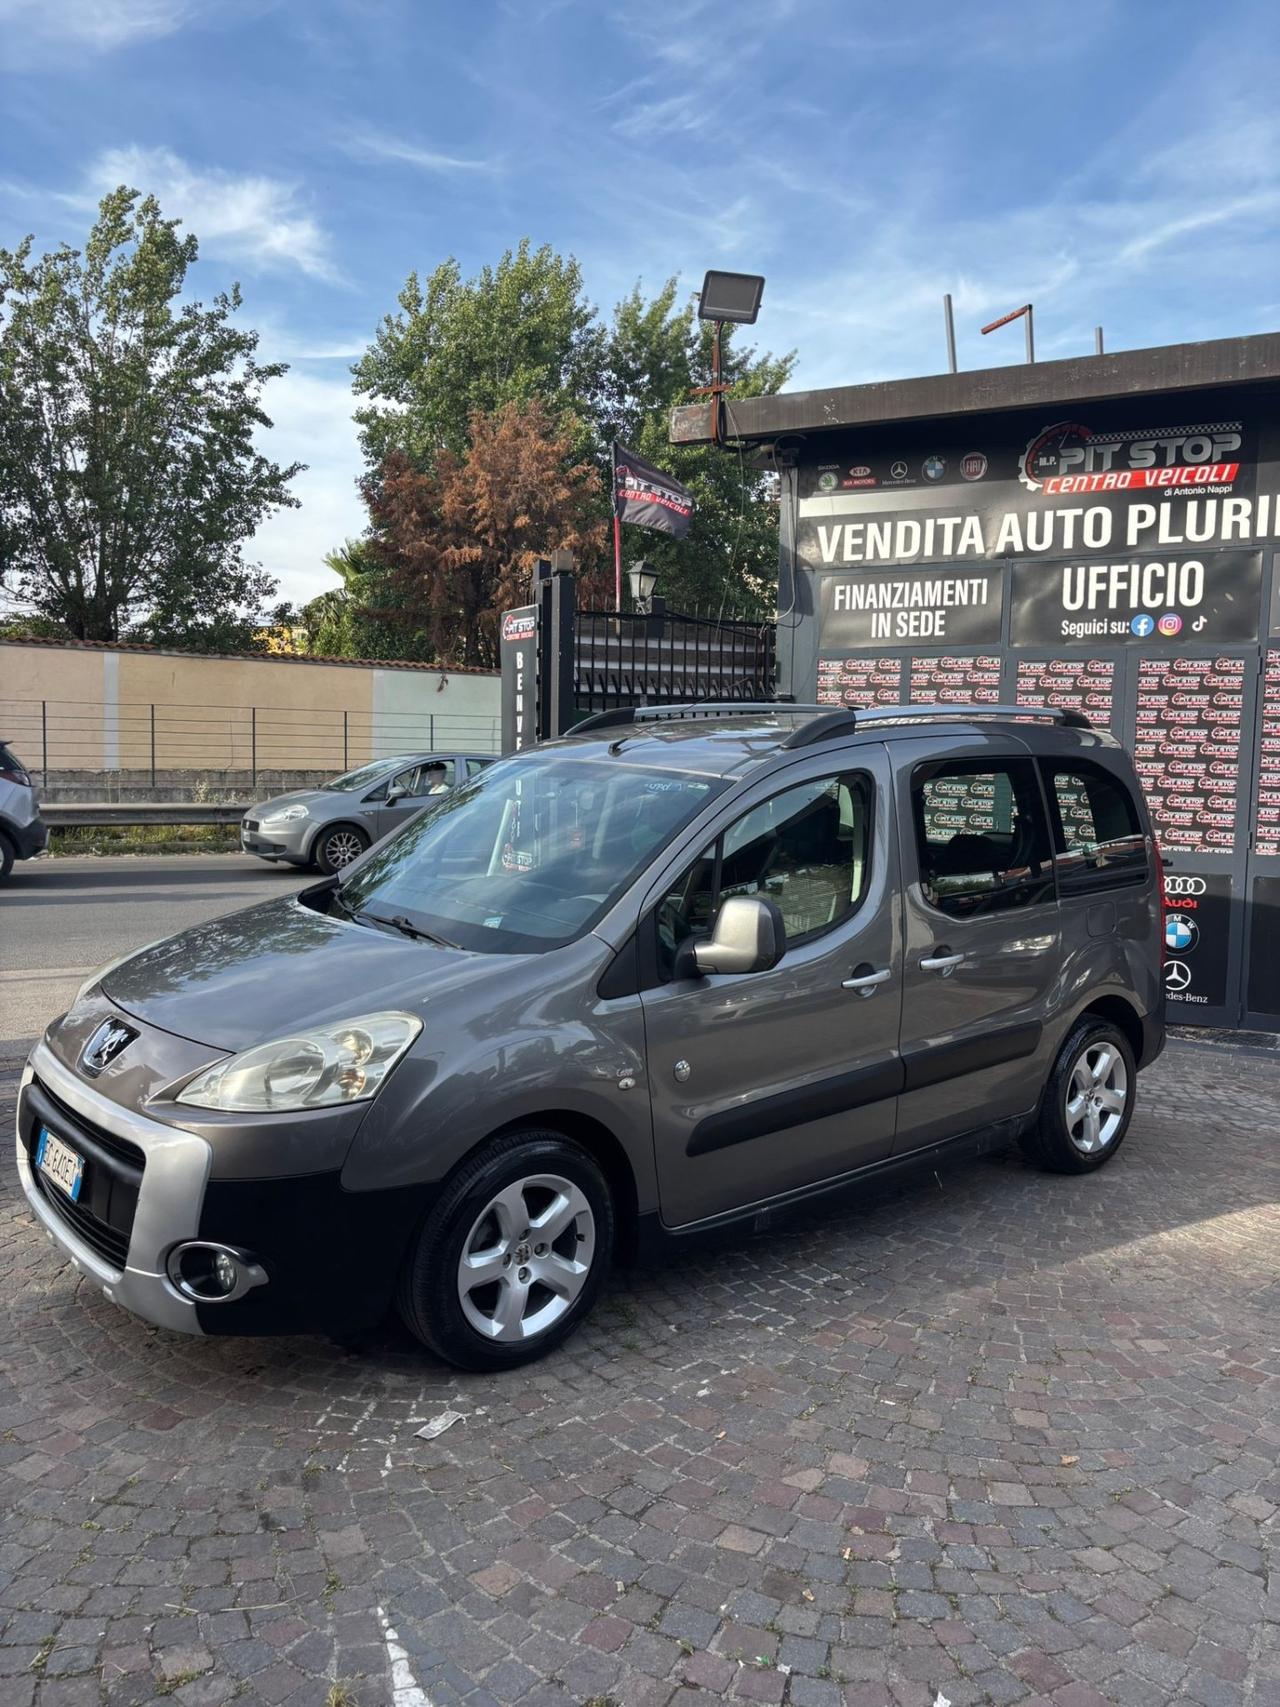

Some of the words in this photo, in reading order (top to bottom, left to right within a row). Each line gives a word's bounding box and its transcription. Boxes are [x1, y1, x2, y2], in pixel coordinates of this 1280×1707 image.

[1058, 443, 1124, 475] PIT
[1128, 433, 1242, 469] STOP
[965, 460, 981, 473] FIAT
[648, 477, 818, 491] PIT
[1046, 472, 1131, 494] CENTRO
[1145, 464, 1231, 484] VEICOLI
[1164, 487, 1173, 496] di
[1174, 485, 1206, 495] Antonio
[1207, 484, 1233, 495] Nappi
[651, 486, 693, 507] STOP
[817, 515, 986, 563] VENDITA
[994, 506, 1113, 554] AUTO
[1126, 494, 1280, 546] PLURI
[834, 578, 988, 611] FINANZIAMENTI
[1062, 560, 1205, 611] UFFICIO
[518, 621, 535, 633] STOP
[871, 613, 892, 638] IN
[896, 610, 946, 637] SEDE
[1061, 618, 1108, 637] Seguici
[1110, 619, 1130, 635] su:
